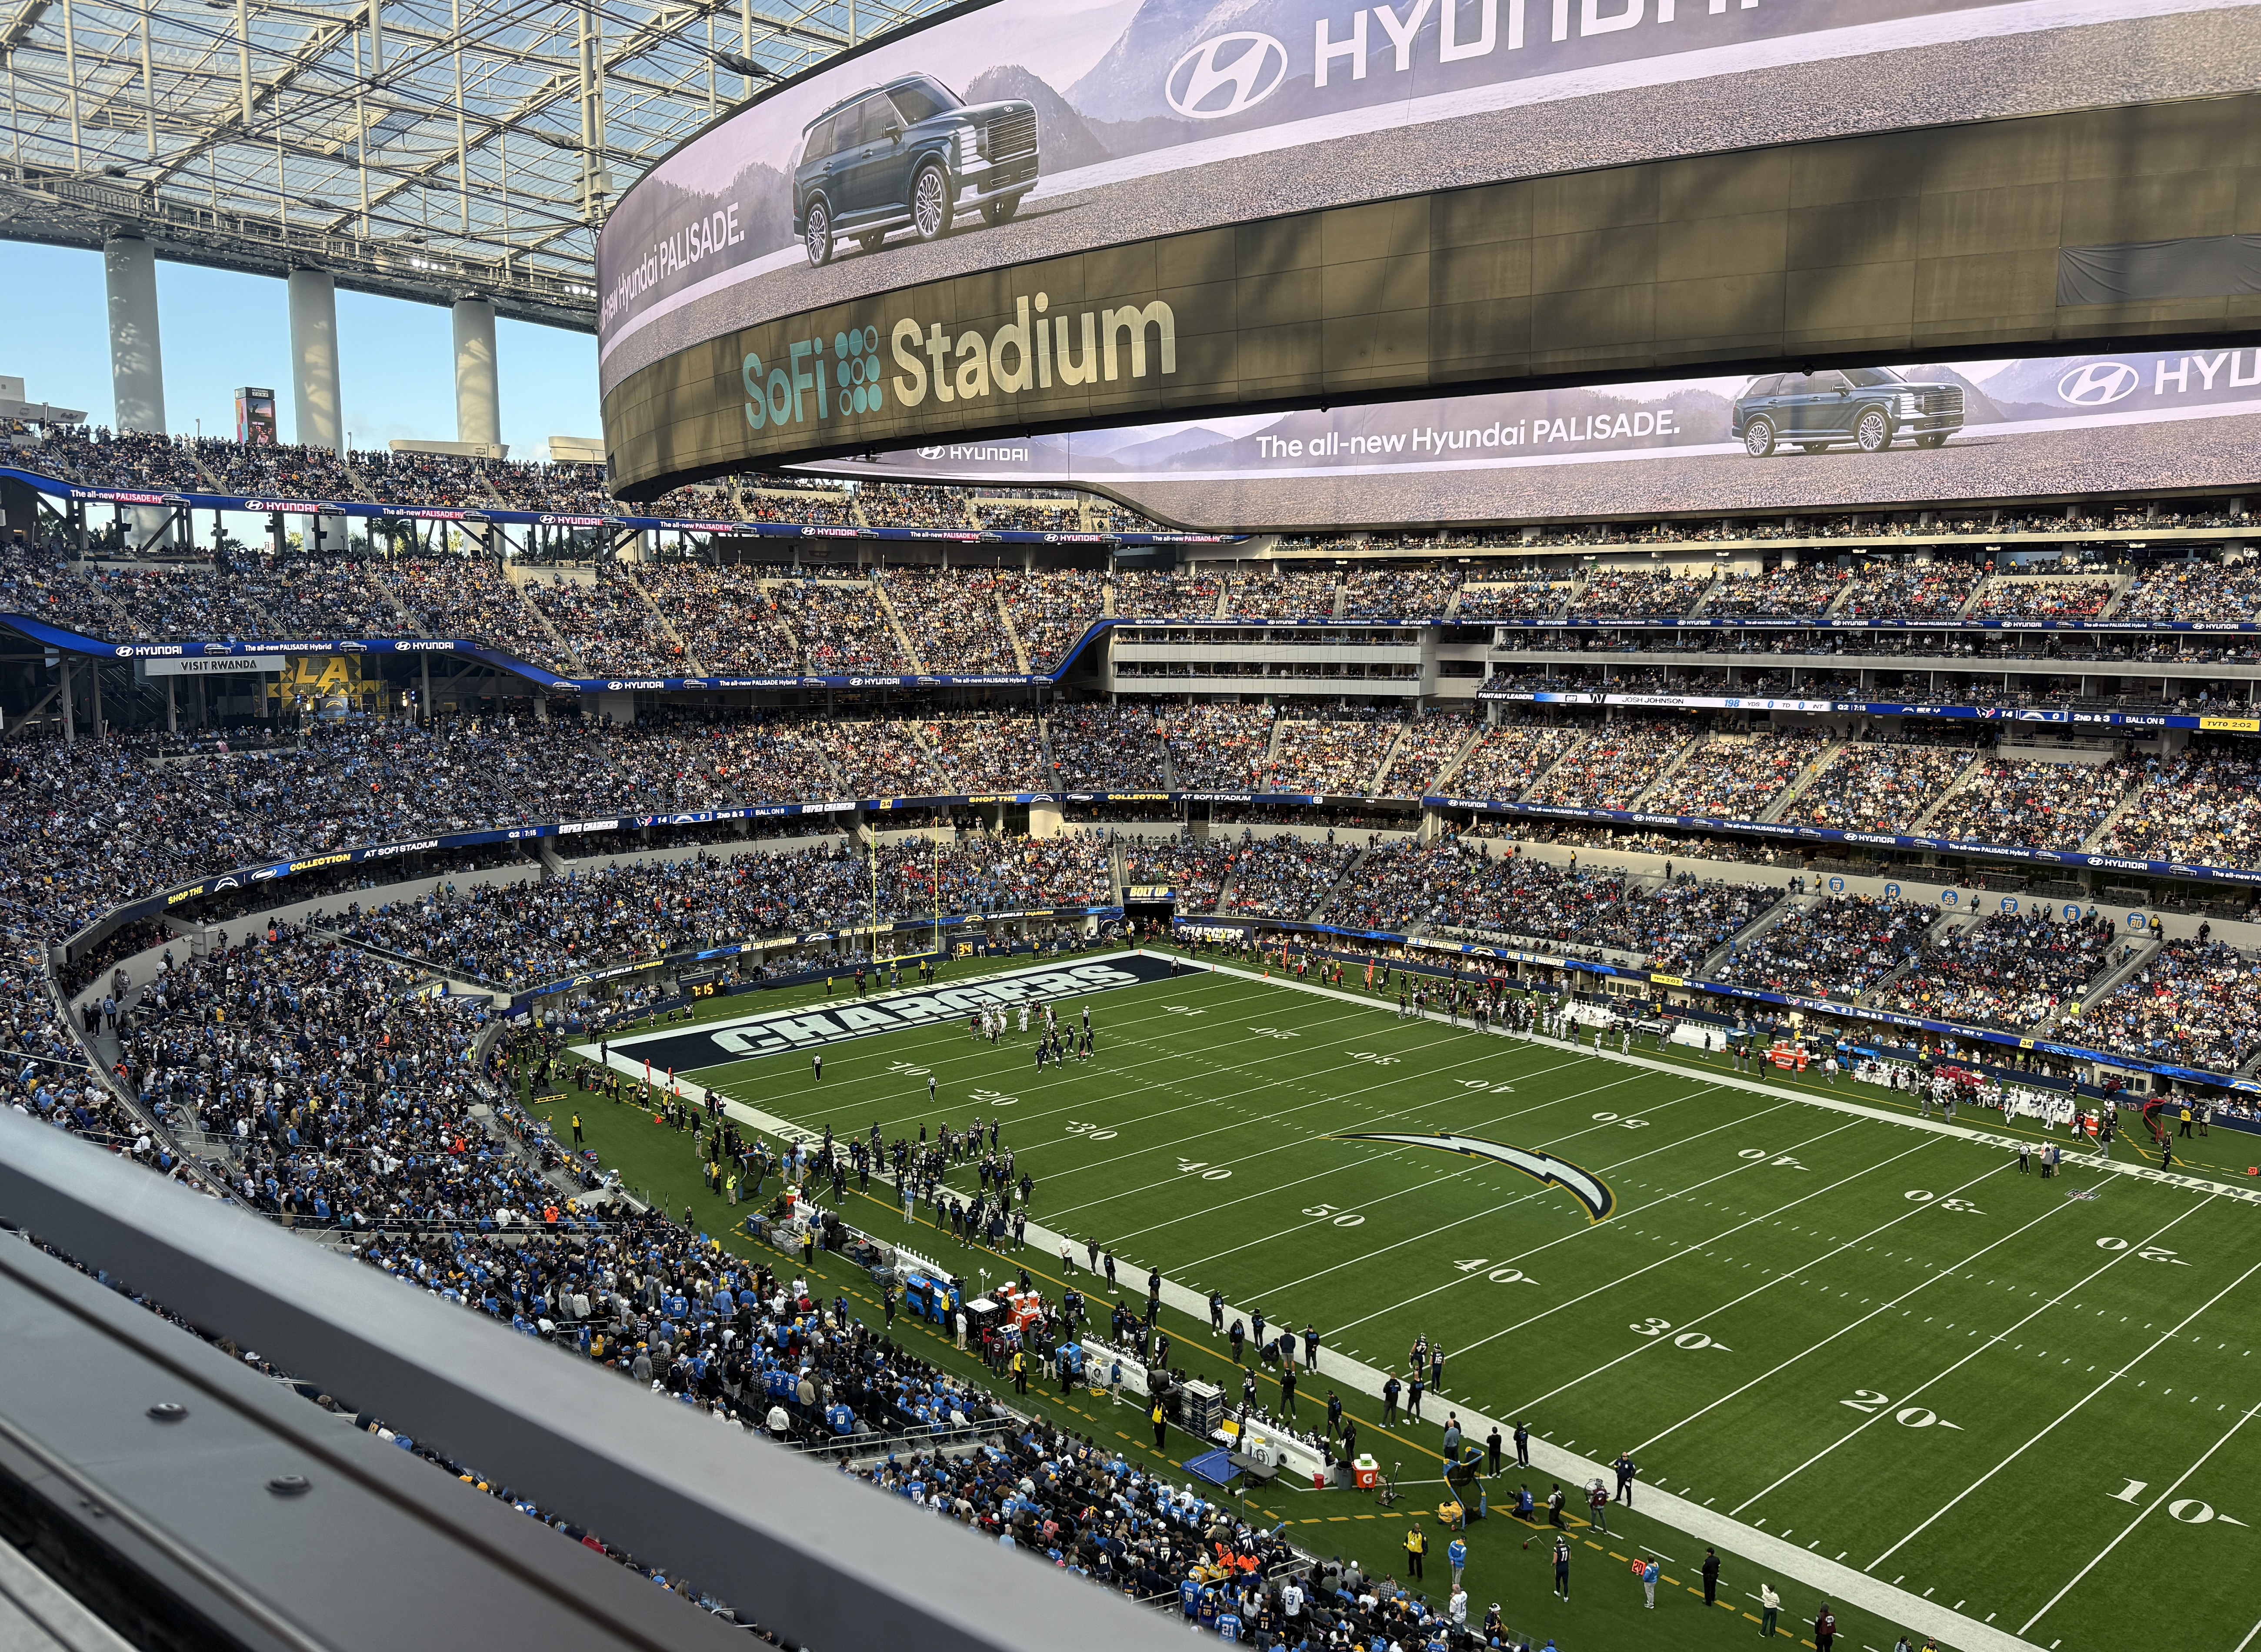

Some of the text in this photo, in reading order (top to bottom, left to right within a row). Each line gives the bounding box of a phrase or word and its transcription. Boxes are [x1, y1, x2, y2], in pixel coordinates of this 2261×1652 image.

[1315, 0, 1758, 87] HYUND
[619, 244, 657, 312] Hyundai
[660, 202, 744, 279] PALISADE.
[742, 292, 1177, 430] SoFi Stadium
[2155, 348, 2261, 395] HYU
[1256, 409, 1681, 458] The all-new Hyundai PALISADE.
[950, 446, 1028, 462] HYUNDAI
[87, 491, 114, 500] all-new
[116, 493, 151, 502] PALISADE
[267, 503, 316, 512] HYUNDAI
[558, 516, 600, 525] HYUNDAI
[136, 646, 182, 655] HYUNDAI
[310, 643, 332, 652] Hybrid
[181, 659, 257, 670] VISIT RWANDA
[1724, 699, 1739, 708] 198
[802, 802, 856, 813] SUPER CHARGERS
[559, 820, 619, 834] SUPER CHARGERS
[1645, 816, 1677, 824] HYUNDAI
[1859, 835, 1895, 844] HYUNDAI
[290, 840, 438, 872] COLLECTION AT SOFI STADIUM
[1981, 847, 2008, 855] PALISADE
[2105, 859, 2148, 870] HYUNDAI
[168, 886, 203, 905] SHOP THE
[1130, 887, 1169, 897] BOLT UP
[839, 924, 894, 937] FEEL THE THUNDER
[740, 936, 797, 952] SEE THE LIGHTNING
[959, 944, 970, 954] 34
[1430, 940, 1463, 952] LIGHTNING
[1506, 951, 1565, 967] FEEL THE THUNDER
[607, 966, 633, 977] ANGELES
[634, 960, 664, 970] CHARGERS
[432, 983, 443, 999] UP
[692, 983, 713, 996] 7:15
[817, 994, 890, 1008] TAKES
[899, 985, 937, 994] ALL
[710, 964, 1140, 1056] CHARGERS
[885, 1063, 931, 1076] 10
[968, 1091, 1018, 1106] 20
[1592, 1112, 1650, 1129] 50
[1065, 1123, 1117, 1140] 30
[1738, 1149, 1800, 1166] 40
[1177, 1162, 1232, 1180] 40
[1904, 1190, 1974, 1211] 30
[1302, 1204, 1365, 1226] 50
[2096, 1237, 2178, 1262] 20
[1454, 1259, 1523, 1282] 40
[637, 1327, 647, 1336] 56
[1139, 1331, 1147, 1341] 31
[1630, 1318, 1711, 1349] 30
[1839, 1389, 1936, 1427] 20
[837, 1415, 845, 1424] 10
[2106, 1478, 2214, 1523] 10
[1561, 1551, 1568, 1561] 11
[1633, 1561, 1644, 1572] 20
[1185, 1591, 1193, 1602] 10
[1287, 1595, 1295, 1605] 3
[1222, 1624, 1234, 1637] 21
